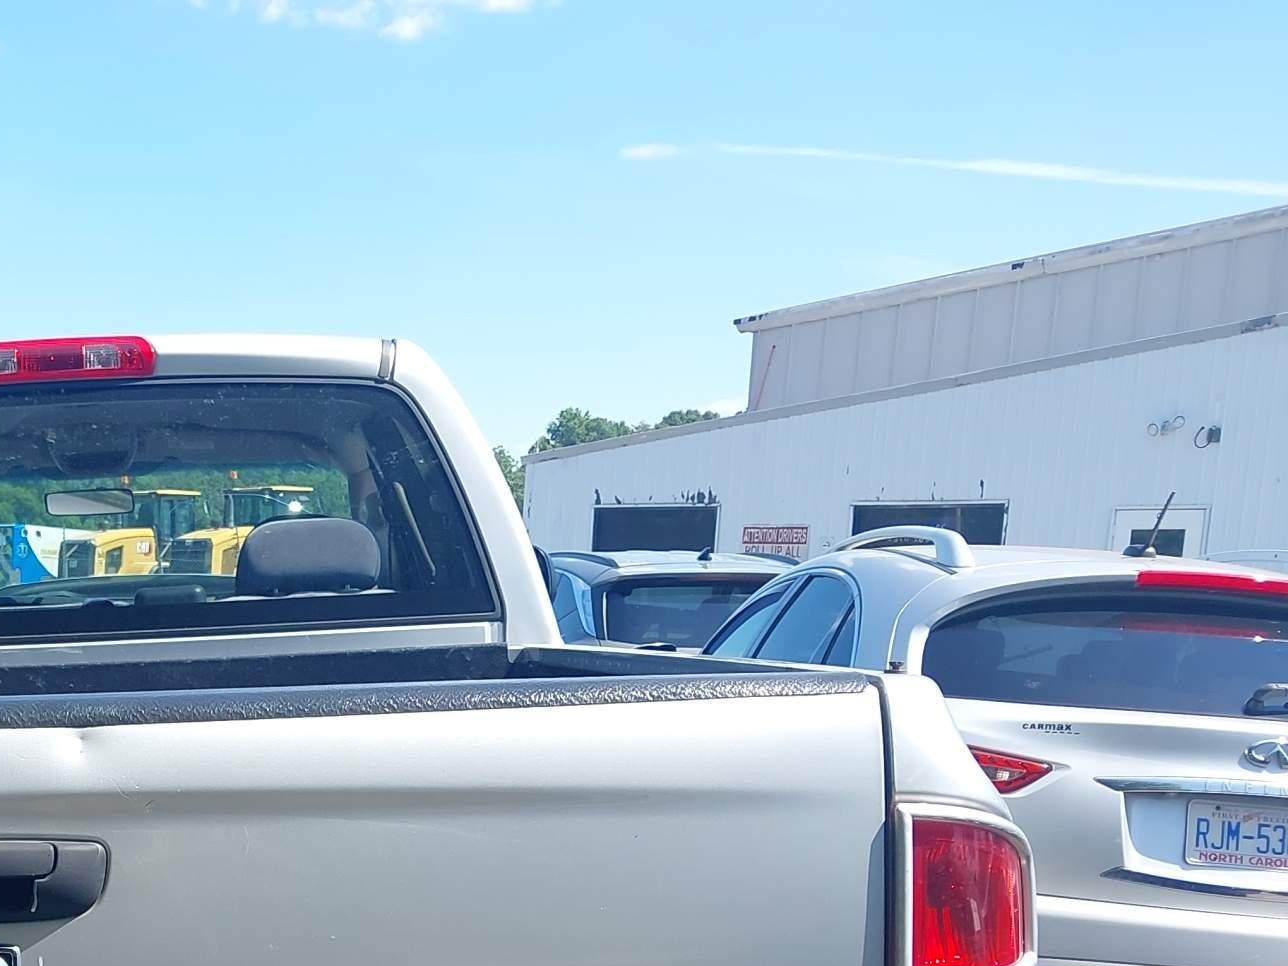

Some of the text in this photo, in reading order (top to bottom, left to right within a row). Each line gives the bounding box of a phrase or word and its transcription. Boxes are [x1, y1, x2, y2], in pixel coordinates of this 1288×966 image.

[744, 528, 807, 542] ATTENTION DRIVERS
[785, 546, 801, 558] ALL
[1195, 817, 1288, 855] RJM-53
[1199, 852, 1244, 864] NORTH
